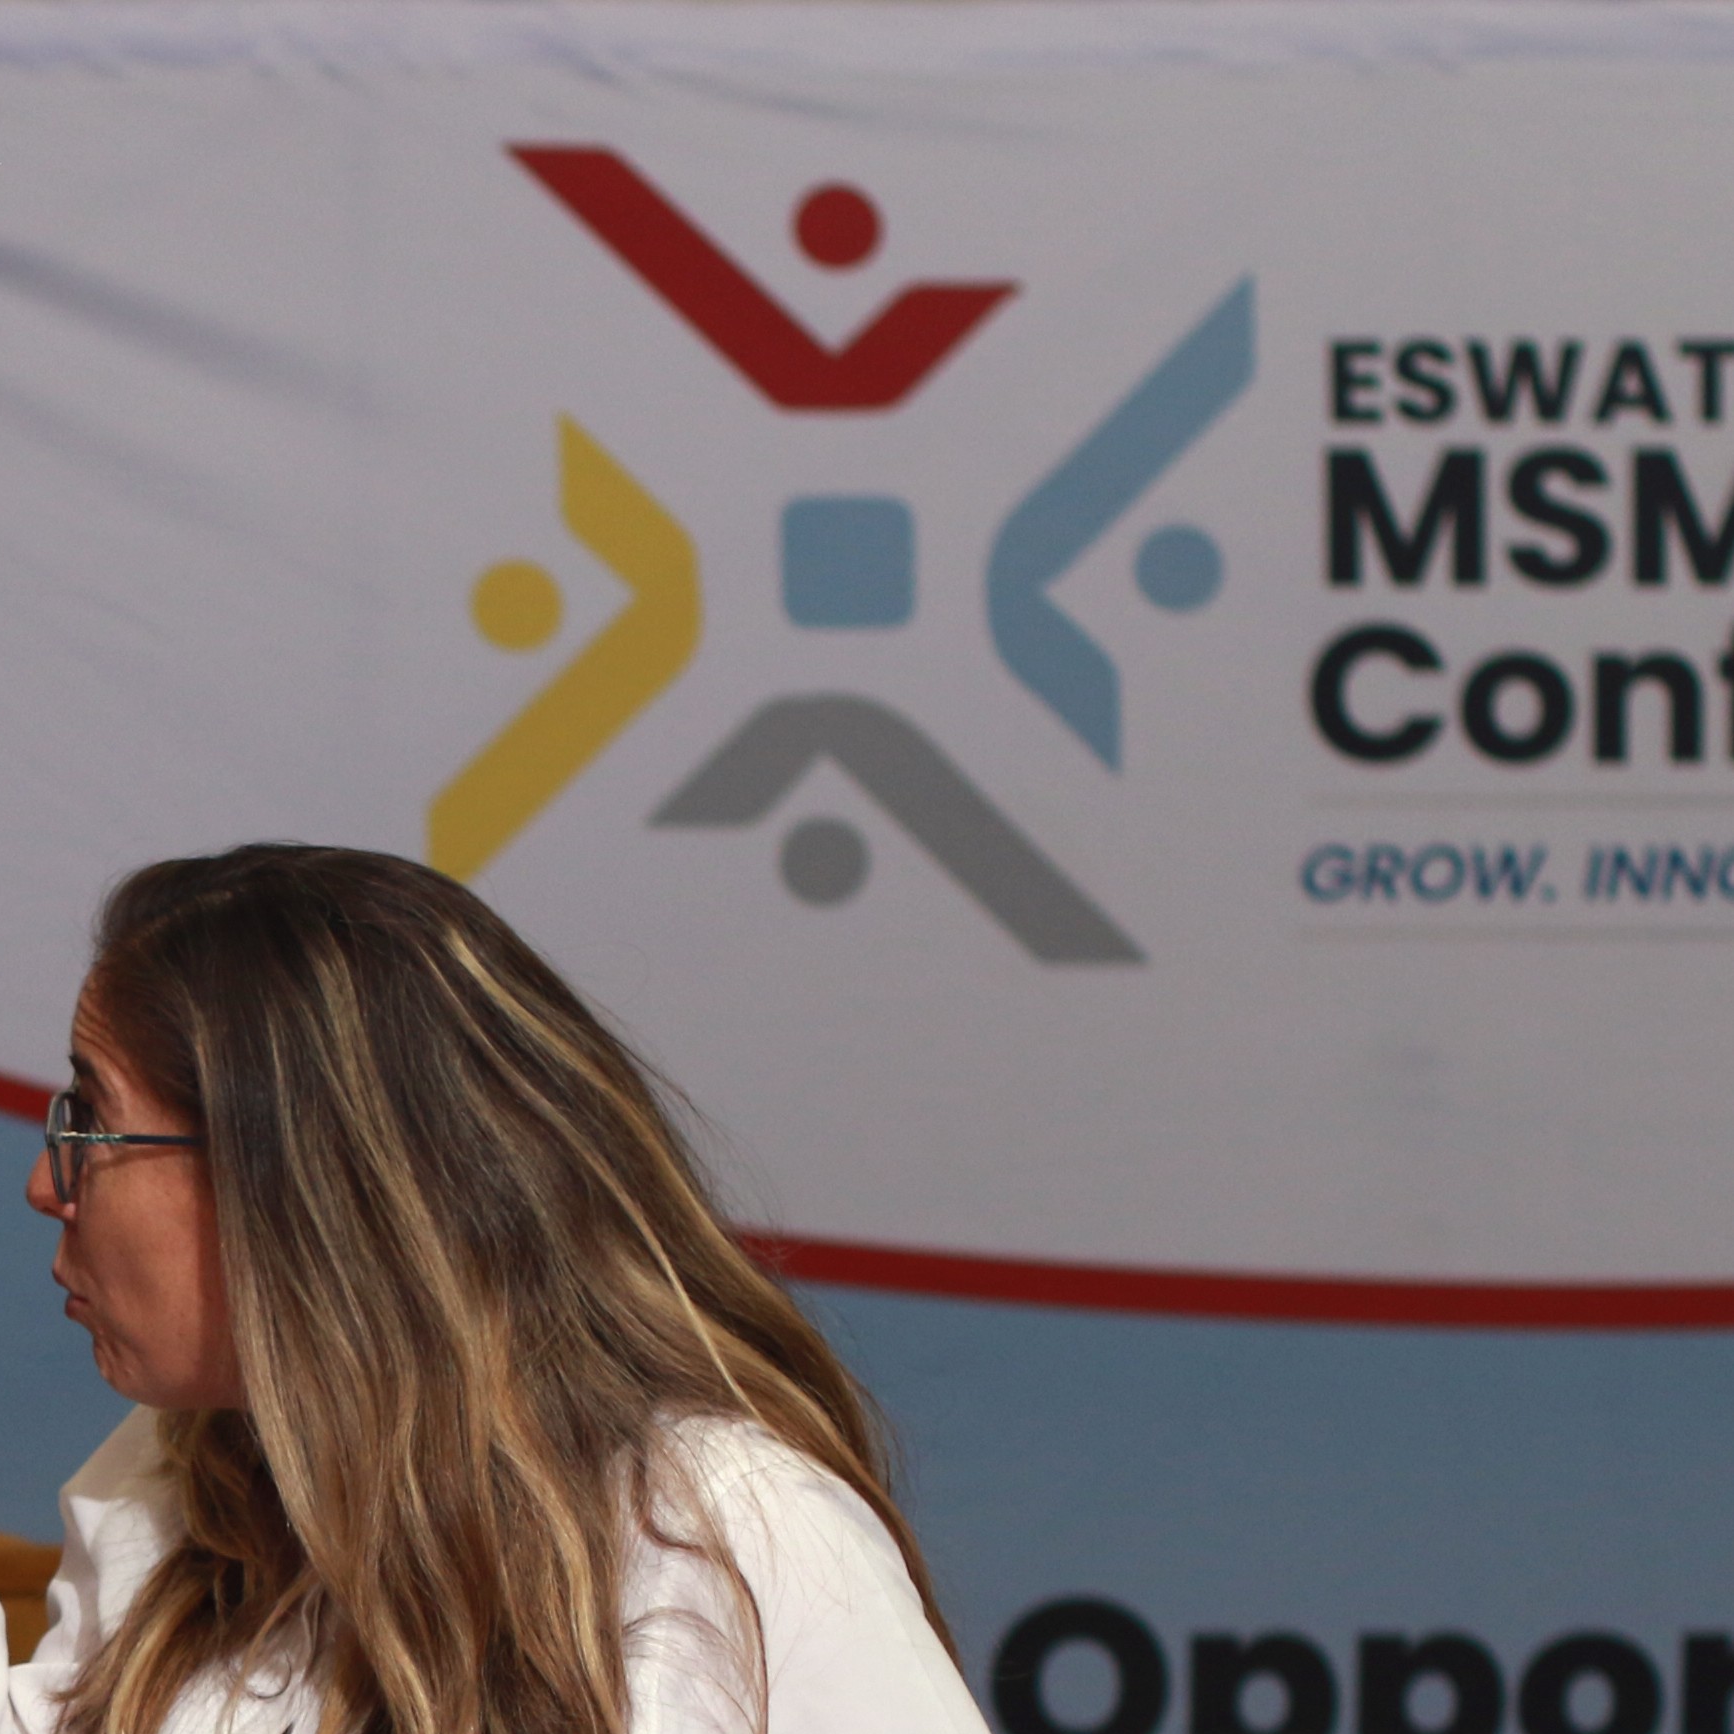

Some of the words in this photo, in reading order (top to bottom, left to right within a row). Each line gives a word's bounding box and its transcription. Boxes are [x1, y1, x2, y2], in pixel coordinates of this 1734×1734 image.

[1327, 336, 1734, 426] ESWAT
[1325, 445, 1734, 590] MSM
[1308, 619, 1734, 766] Con
[1299, 841, 1556, 902] GROW.
[1582, 841, 1734, 902] INN
